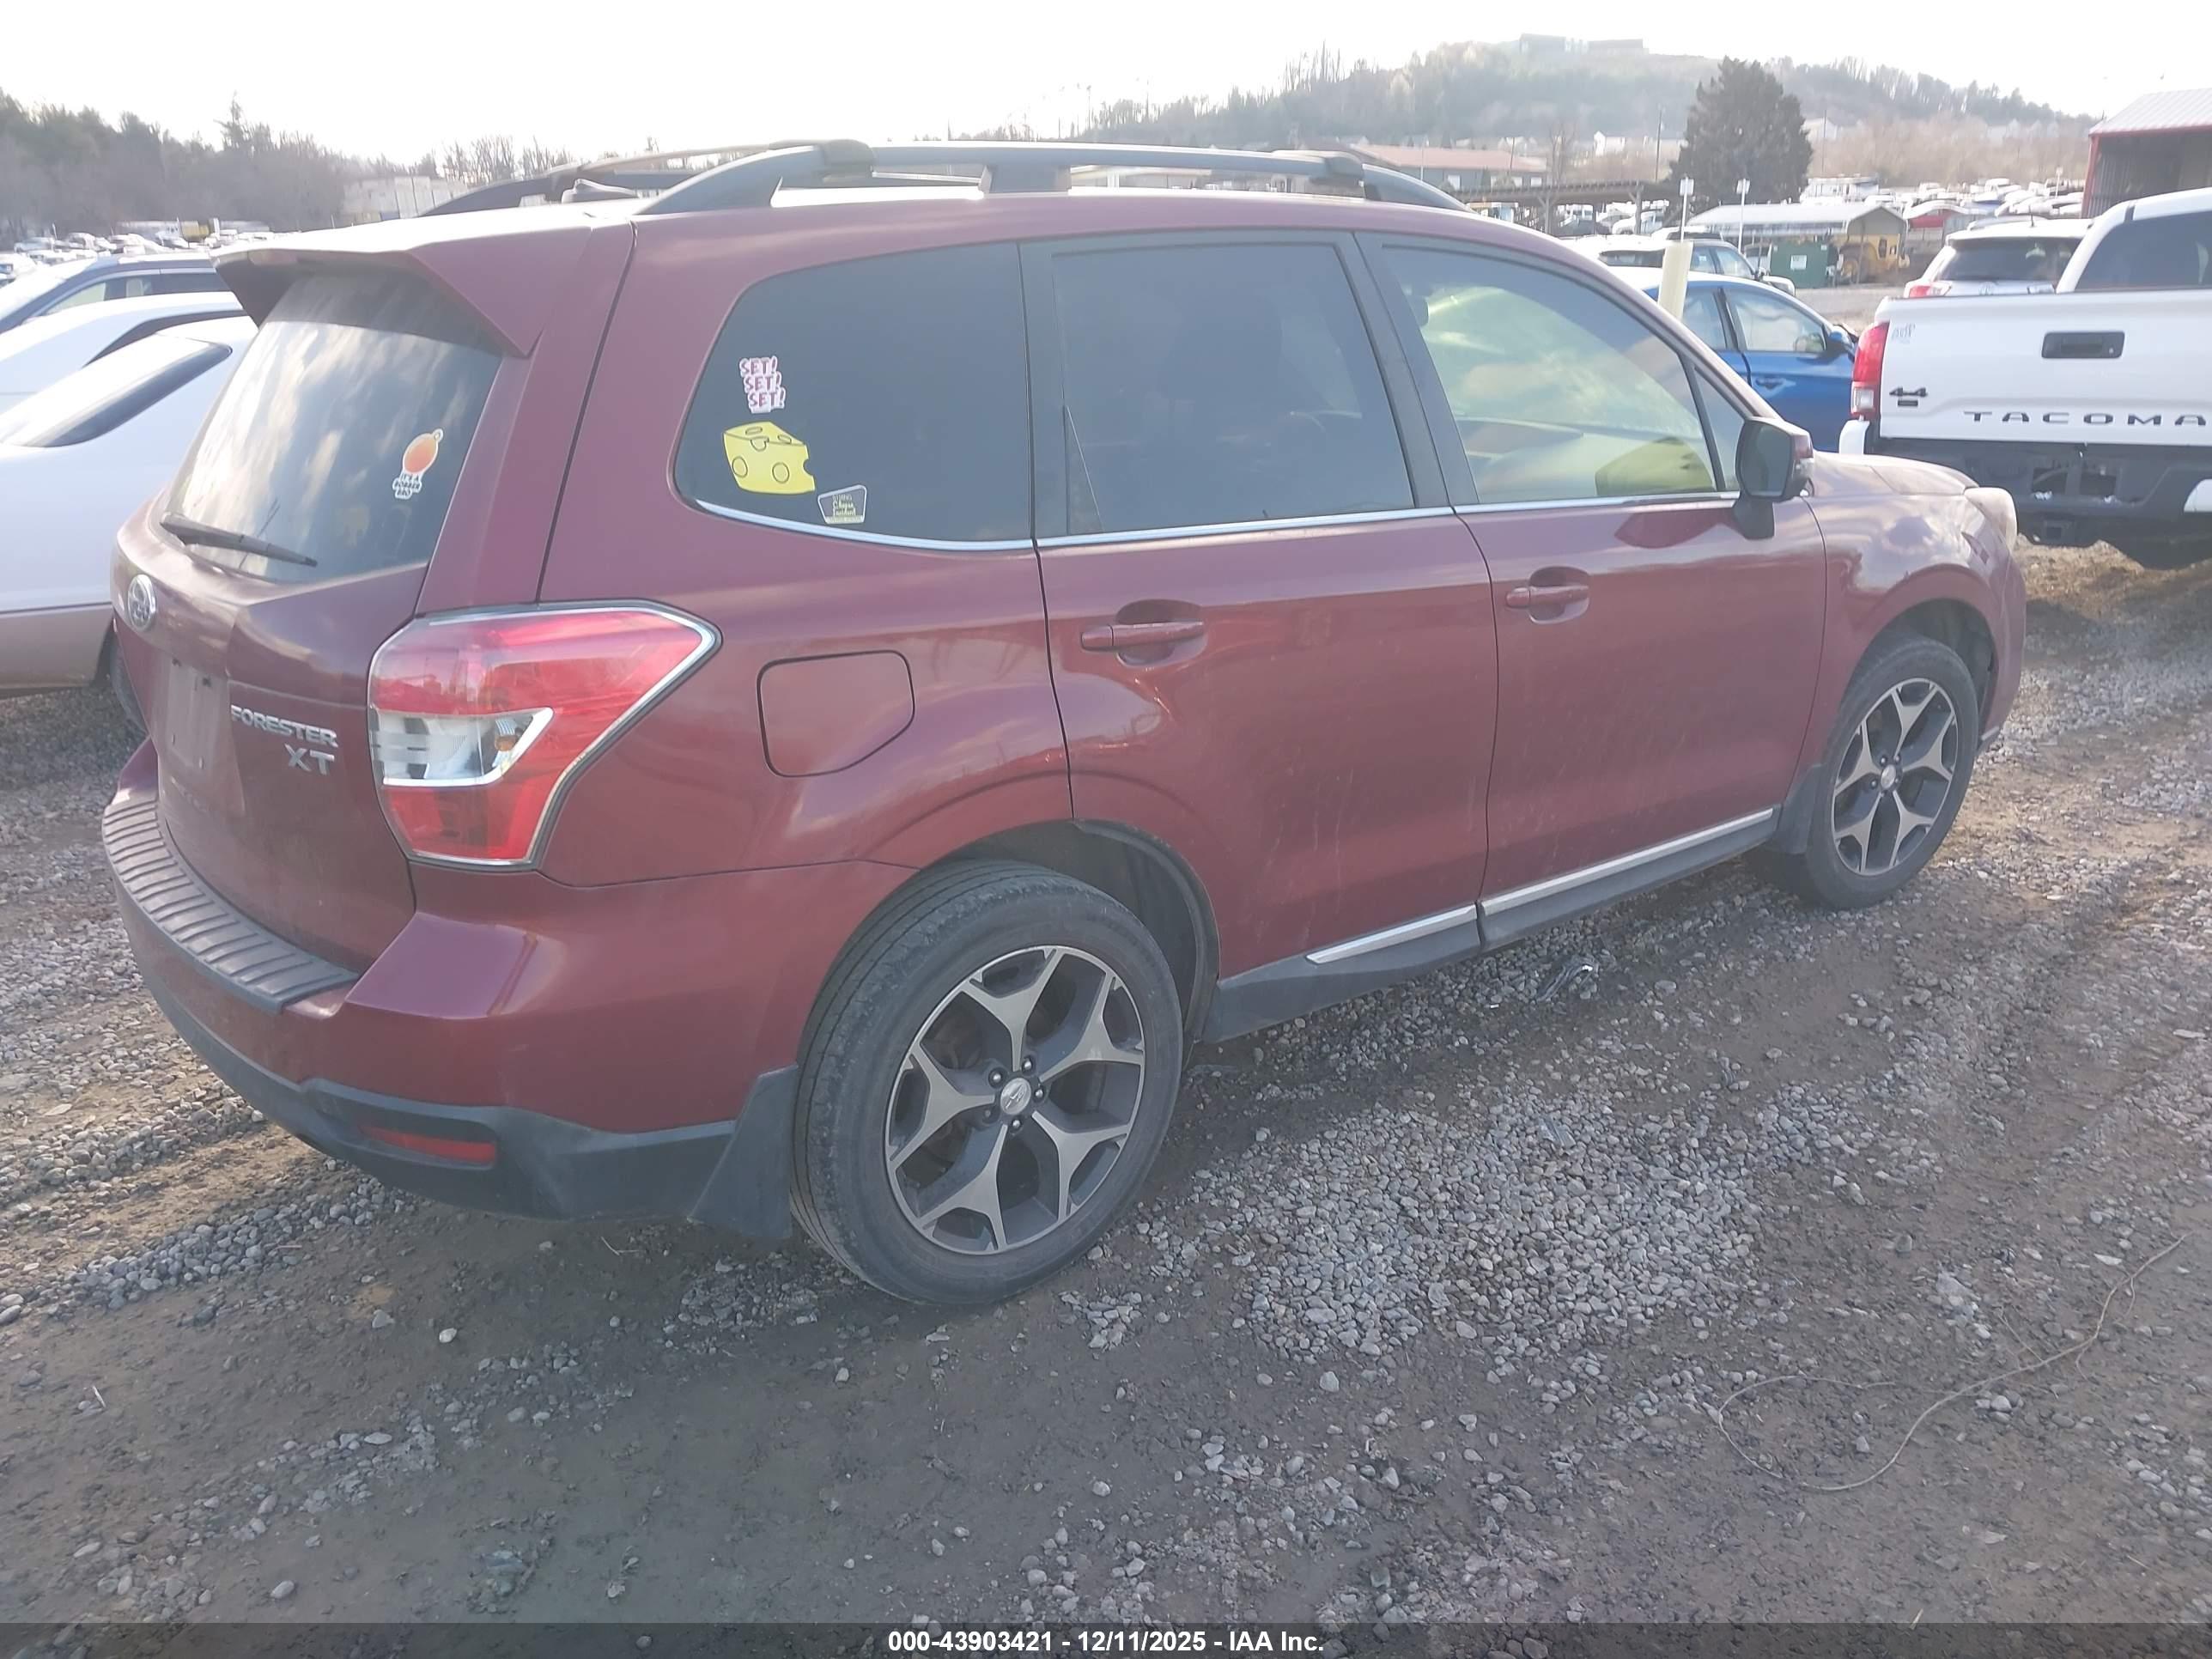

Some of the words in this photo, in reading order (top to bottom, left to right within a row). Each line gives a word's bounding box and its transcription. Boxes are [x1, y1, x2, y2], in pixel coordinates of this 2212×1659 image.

[741, 358, 776, 375] SET!
[745, 373, 781, 392] SET!
[749, 388, 785, 408] SET!
[1963, 410, 2207, 426] TACOMA
[230, 704, 339, 748] FORESTER
[284, 743, 335, 775] XT
